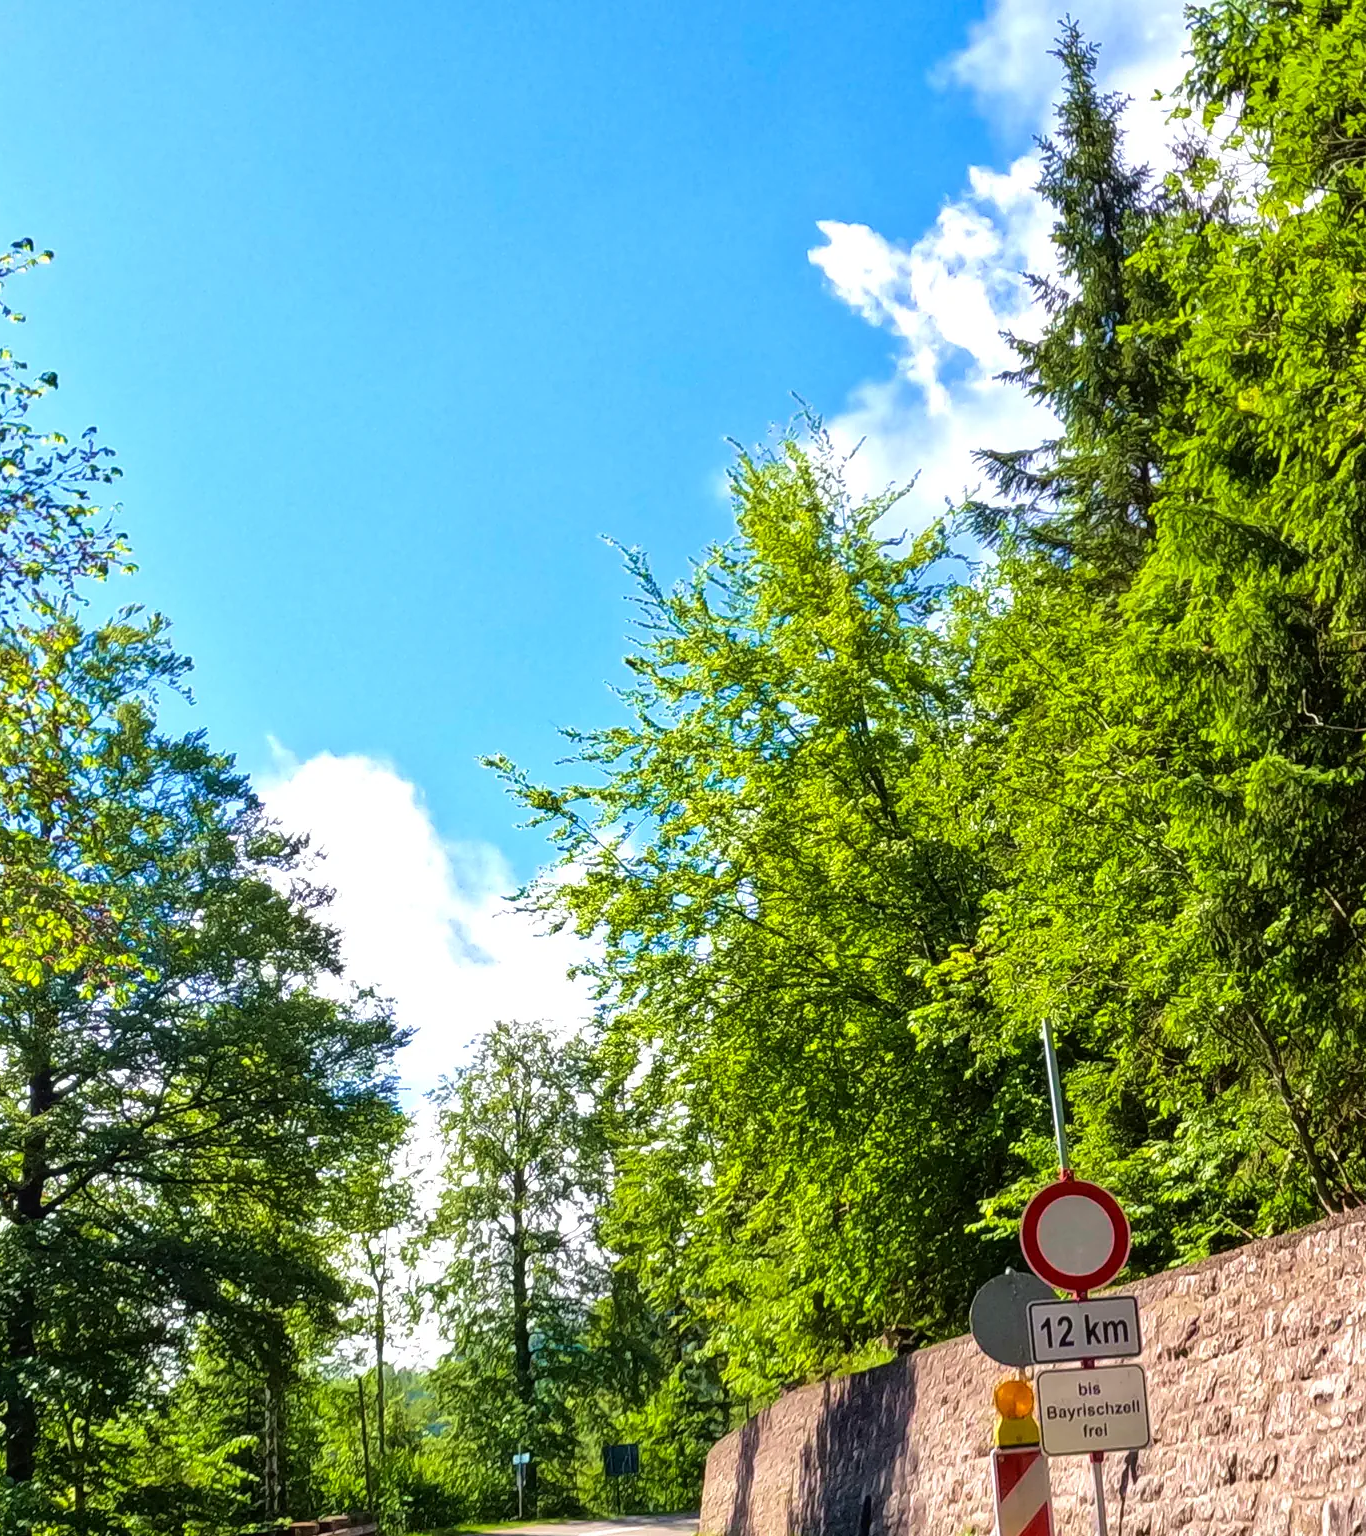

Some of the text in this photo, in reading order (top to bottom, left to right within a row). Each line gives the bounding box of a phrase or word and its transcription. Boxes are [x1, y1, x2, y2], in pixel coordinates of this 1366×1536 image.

[1040, 1314, 1129, 1349] 12 km
[1078, 1382, 1101, 1396] bis
[1046, 1400, 1140, 1422] Bayrischzell
[1083, 1423, 1108, 1438] frei
